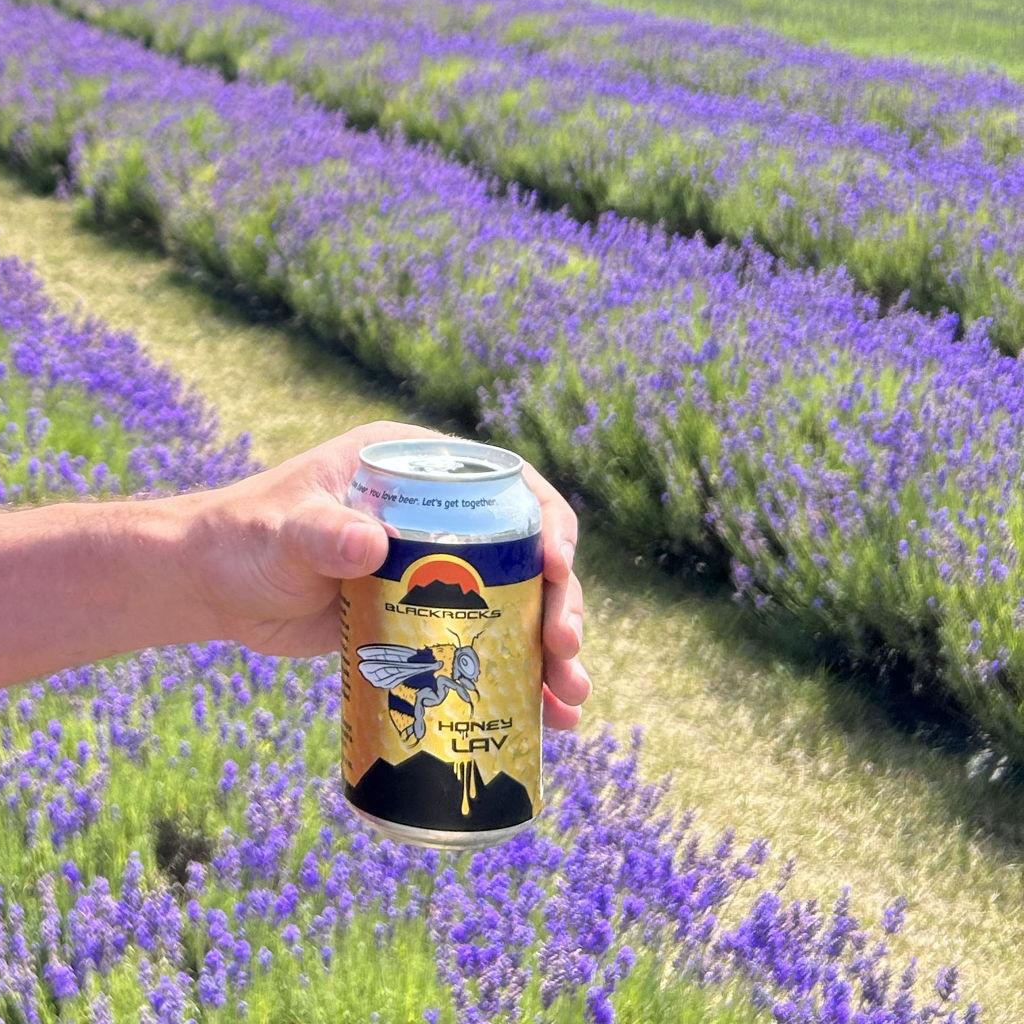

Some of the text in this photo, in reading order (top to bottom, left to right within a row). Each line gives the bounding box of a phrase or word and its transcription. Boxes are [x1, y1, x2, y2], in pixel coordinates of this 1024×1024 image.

[369, 488, 381, 498] You
[381, 490, 397, 502] love
[398, 494, 419, 506] beer.
[422, 497, 442, 507] Let's
[444, 498, 459, 509] get
[384, 602, 502, 621] BLACKROCKS
[437, 716, 514, 733] HONEY
[450, 734, 510, 753] LAV
